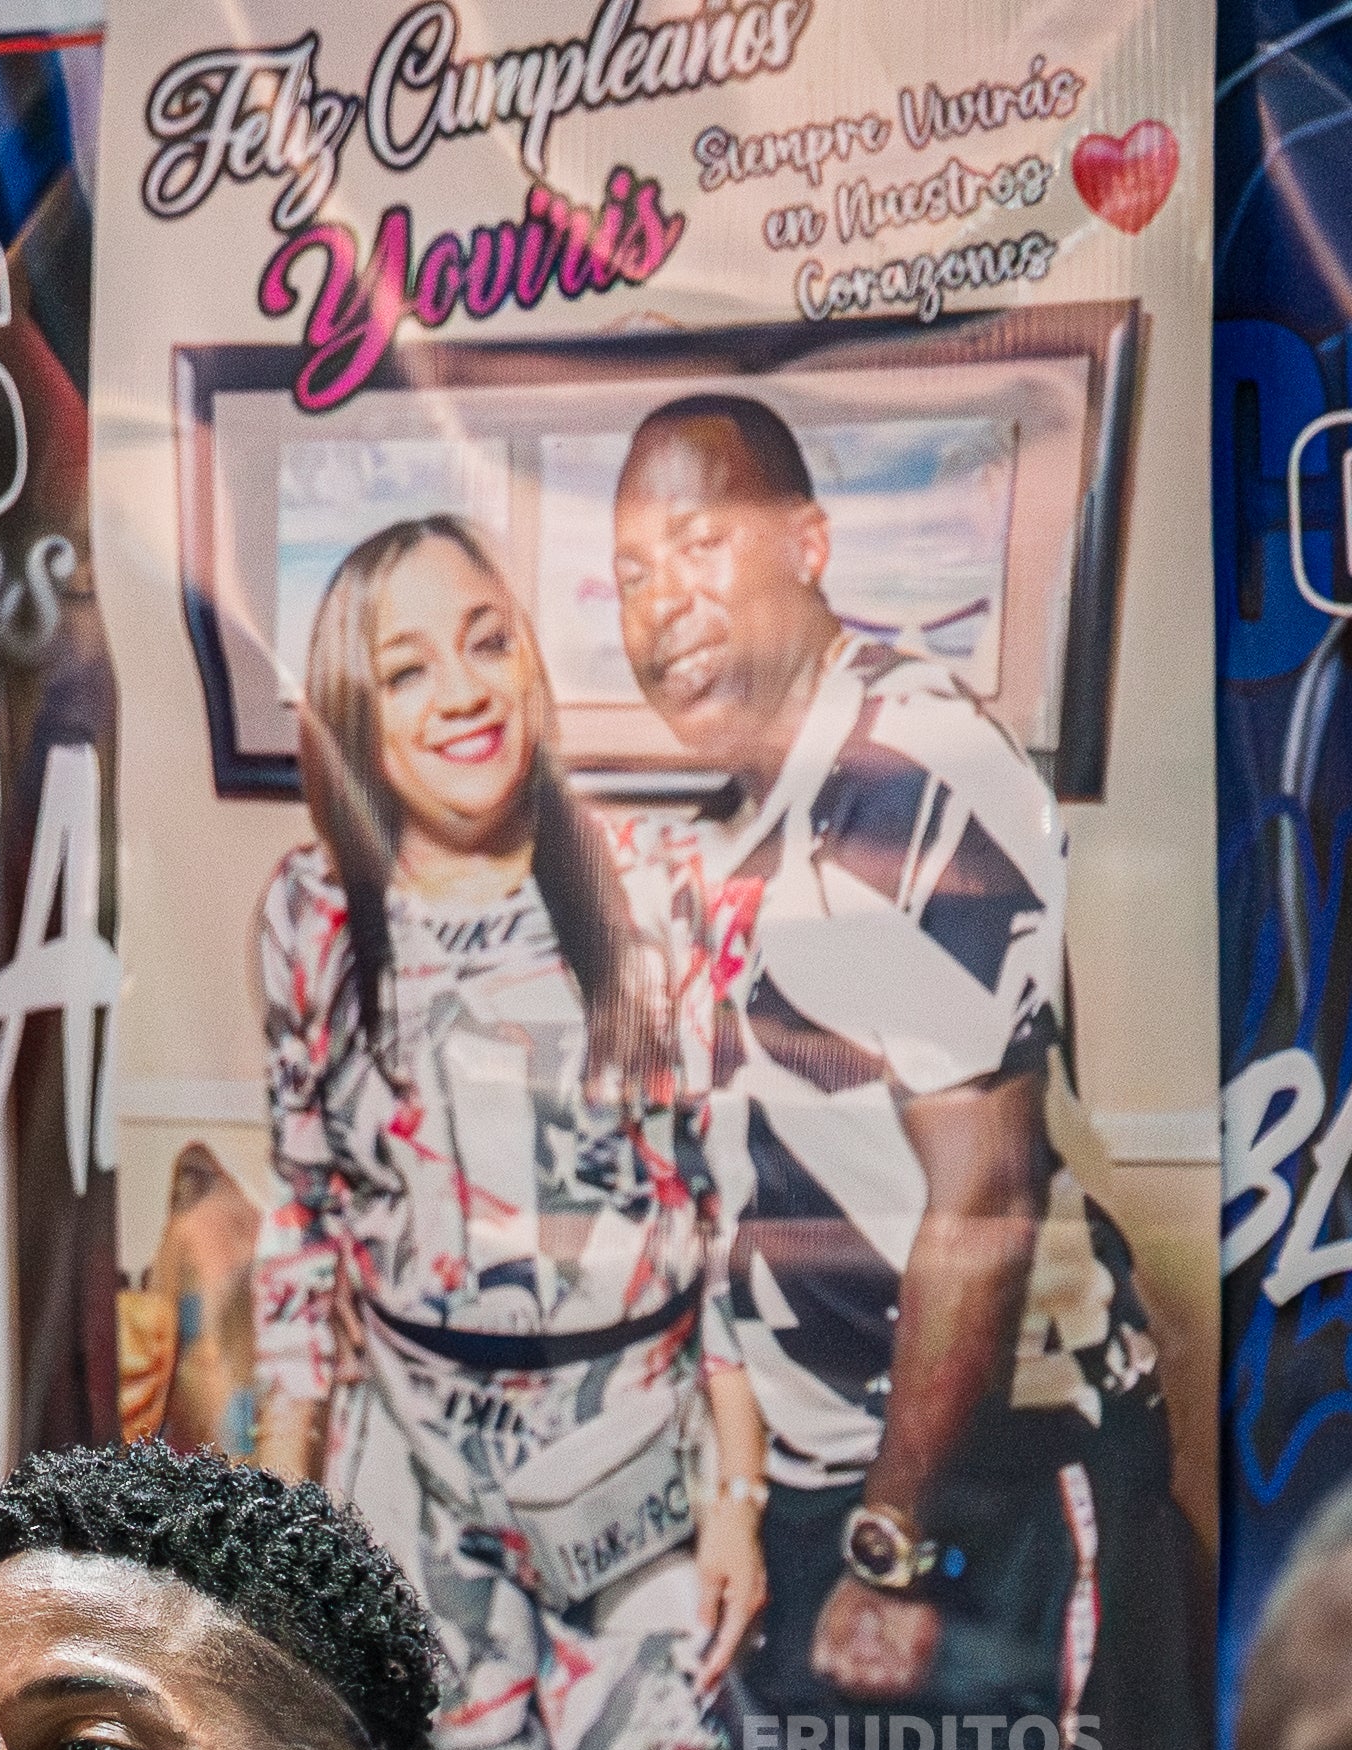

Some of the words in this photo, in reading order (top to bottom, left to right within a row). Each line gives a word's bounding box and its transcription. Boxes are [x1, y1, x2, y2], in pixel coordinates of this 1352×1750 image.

[142, 30, 360, 231] Feliz
[692, 112, 892, 192] Siempre
[898, 54, 1086, 150] Vivirás
[762, 203, 828, 251] en
[834, 152, 1052, 245] Nuestros
[794, 229, 1058, 323] Corazones
